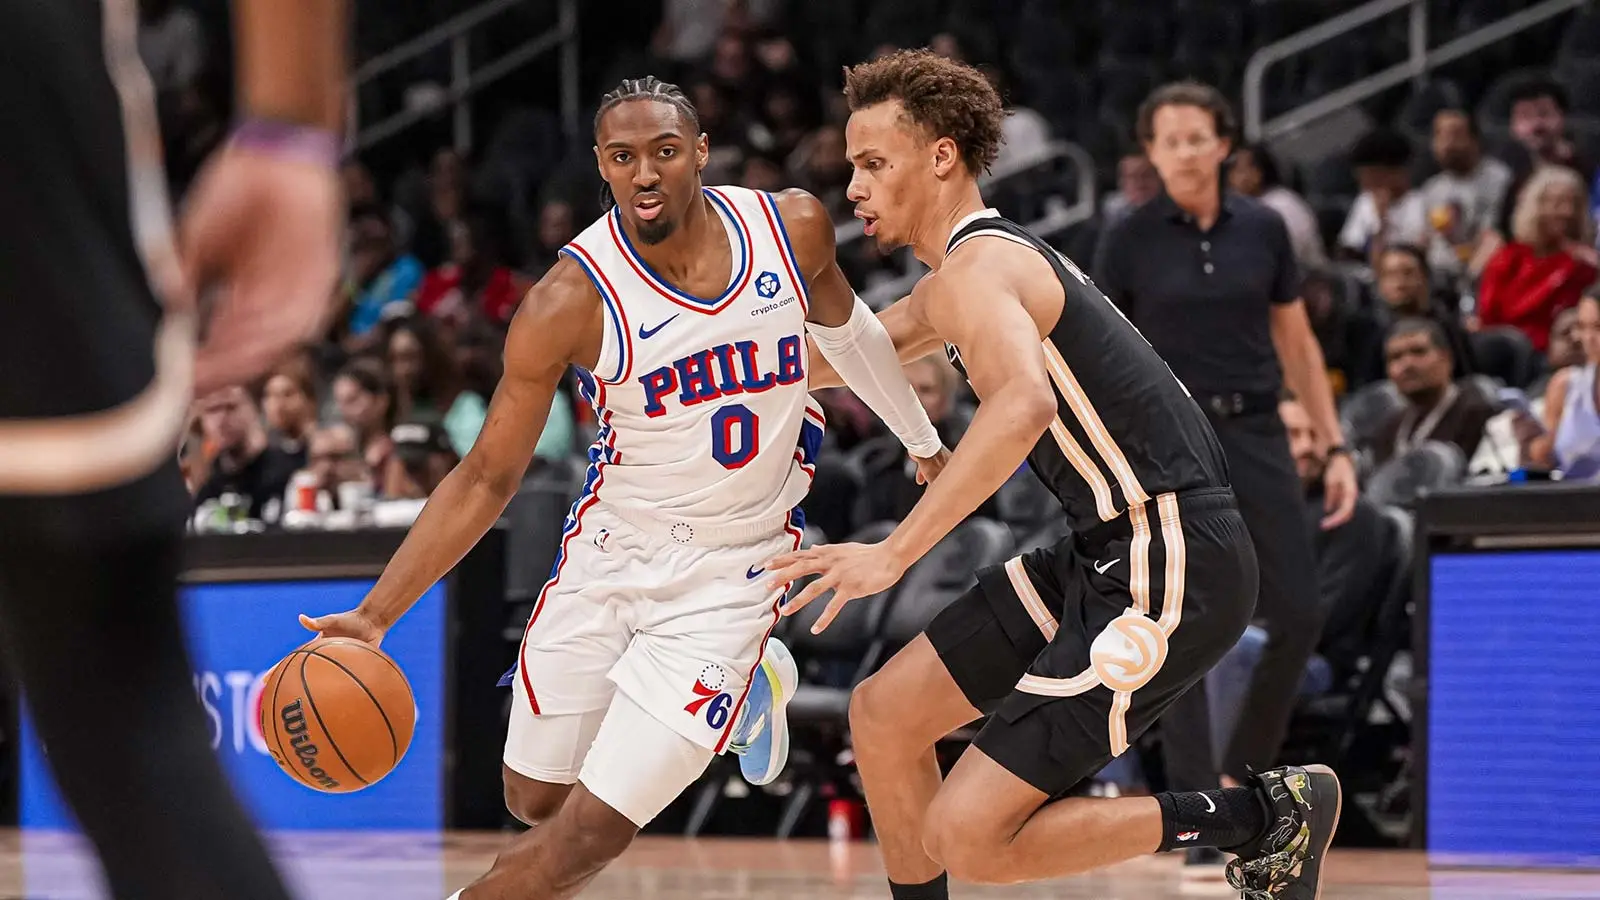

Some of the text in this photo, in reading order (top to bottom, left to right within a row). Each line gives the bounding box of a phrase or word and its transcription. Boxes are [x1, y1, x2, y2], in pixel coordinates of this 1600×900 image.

[750, 296, 795, 316] crypto.com
[638, 334, 804, 418] PHILA
[711, 404, 759, 470] 0
[684, 679, 732, 729] 76
[281, 696, 340, 789] Wilson
